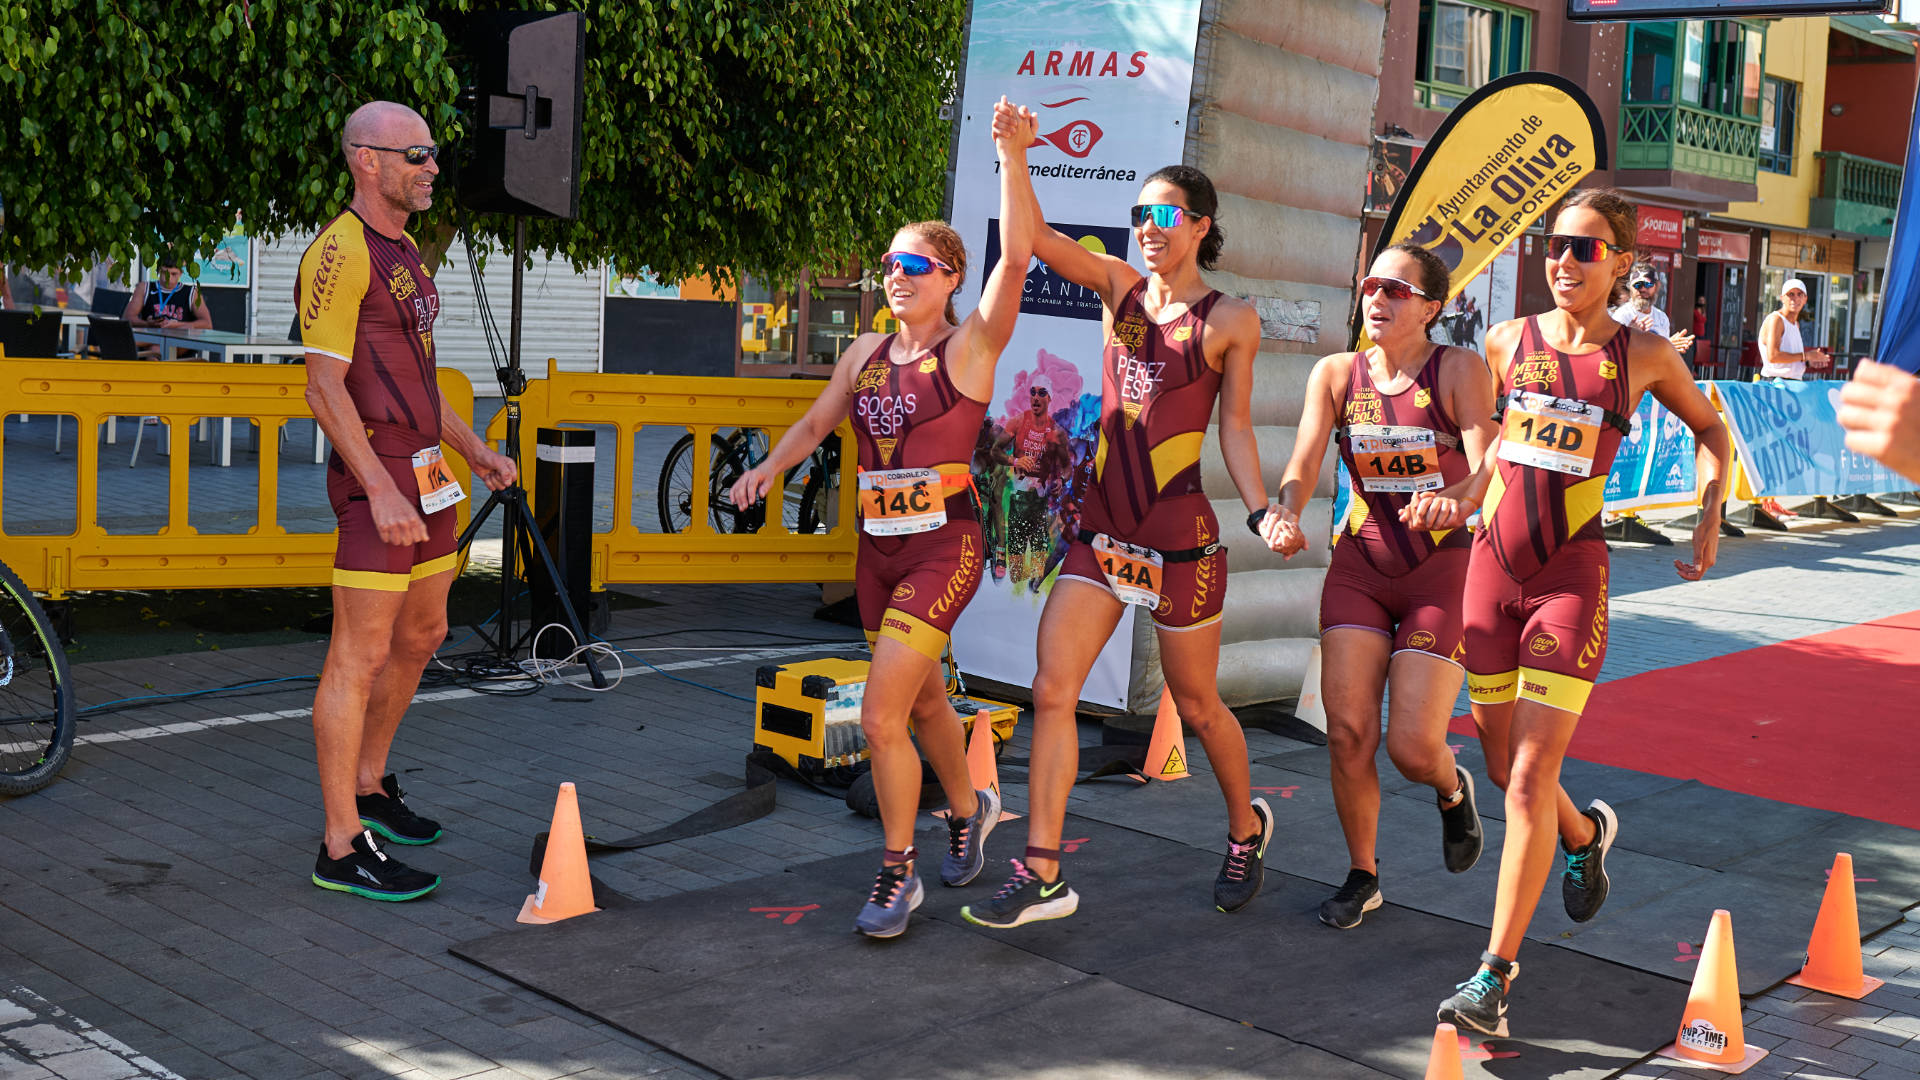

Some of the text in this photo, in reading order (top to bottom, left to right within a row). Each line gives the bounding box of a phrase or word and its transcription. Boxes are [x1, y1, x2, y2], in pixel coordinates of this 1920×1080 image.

[1016, 50, 1149, 78] ARMAS
[994, 161, 1137, 182] Tmediterránea
[1437, 114, 1544, 220] Ayuntamiento de
[1451, 133, 1576, 243] La Oliva
[1488, 161, 1582, 246] DEPORTES
[1640, 215, 1678, 233] SPORTIUM
[323, 254, 346, 312] CANARIAS
[414, 294, 439, 316] RUIZ
[417, 311, 434, 332] ESP
[1117, 355, 1167, 382] PÉREZ
[1511, 360, 1559, 379] METRO
[1121, 377, 1153, 400] ESP
[857, 394, 917, 416] SOCAS
[1345, 399, 1382, 418] METRO
[868, 414, 904, 436] ESP
[1520, 418, 1583, 452] 14D
[1370, 454, 1427, 476] 14B
[867, 474, 888, 487] TRI
[887, 470, 930, 480] CORRALEJO
[873, 489, 932, 516] 14C
[928, 534, 975, 619] Wilier
[1103, 557, 1153, 590] 14A
[1535, 637, 1556, 647] RUN
